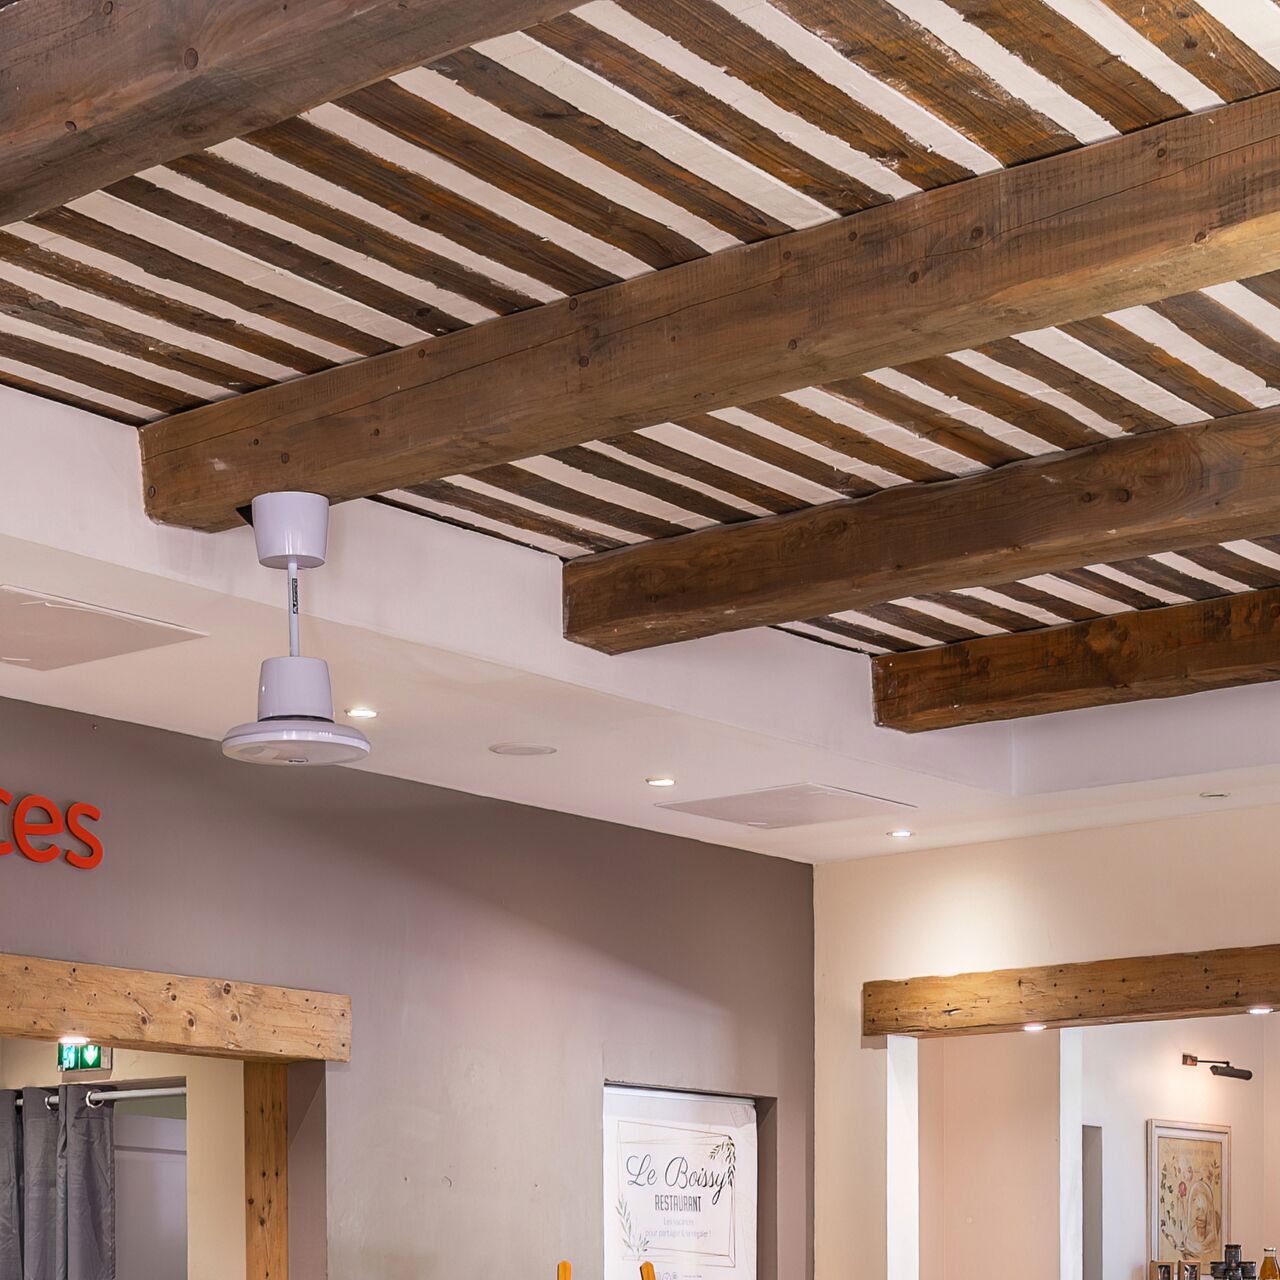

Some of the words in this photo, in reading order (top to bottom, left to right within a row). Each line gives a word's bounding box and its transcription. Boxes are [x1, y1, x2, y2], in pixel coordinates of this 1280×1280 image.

[626, 1153, 658, 1187] Le
[665, 1156, 727, 1206] Boissy
[654, 1194, 702, 1213] RESTAURANT
